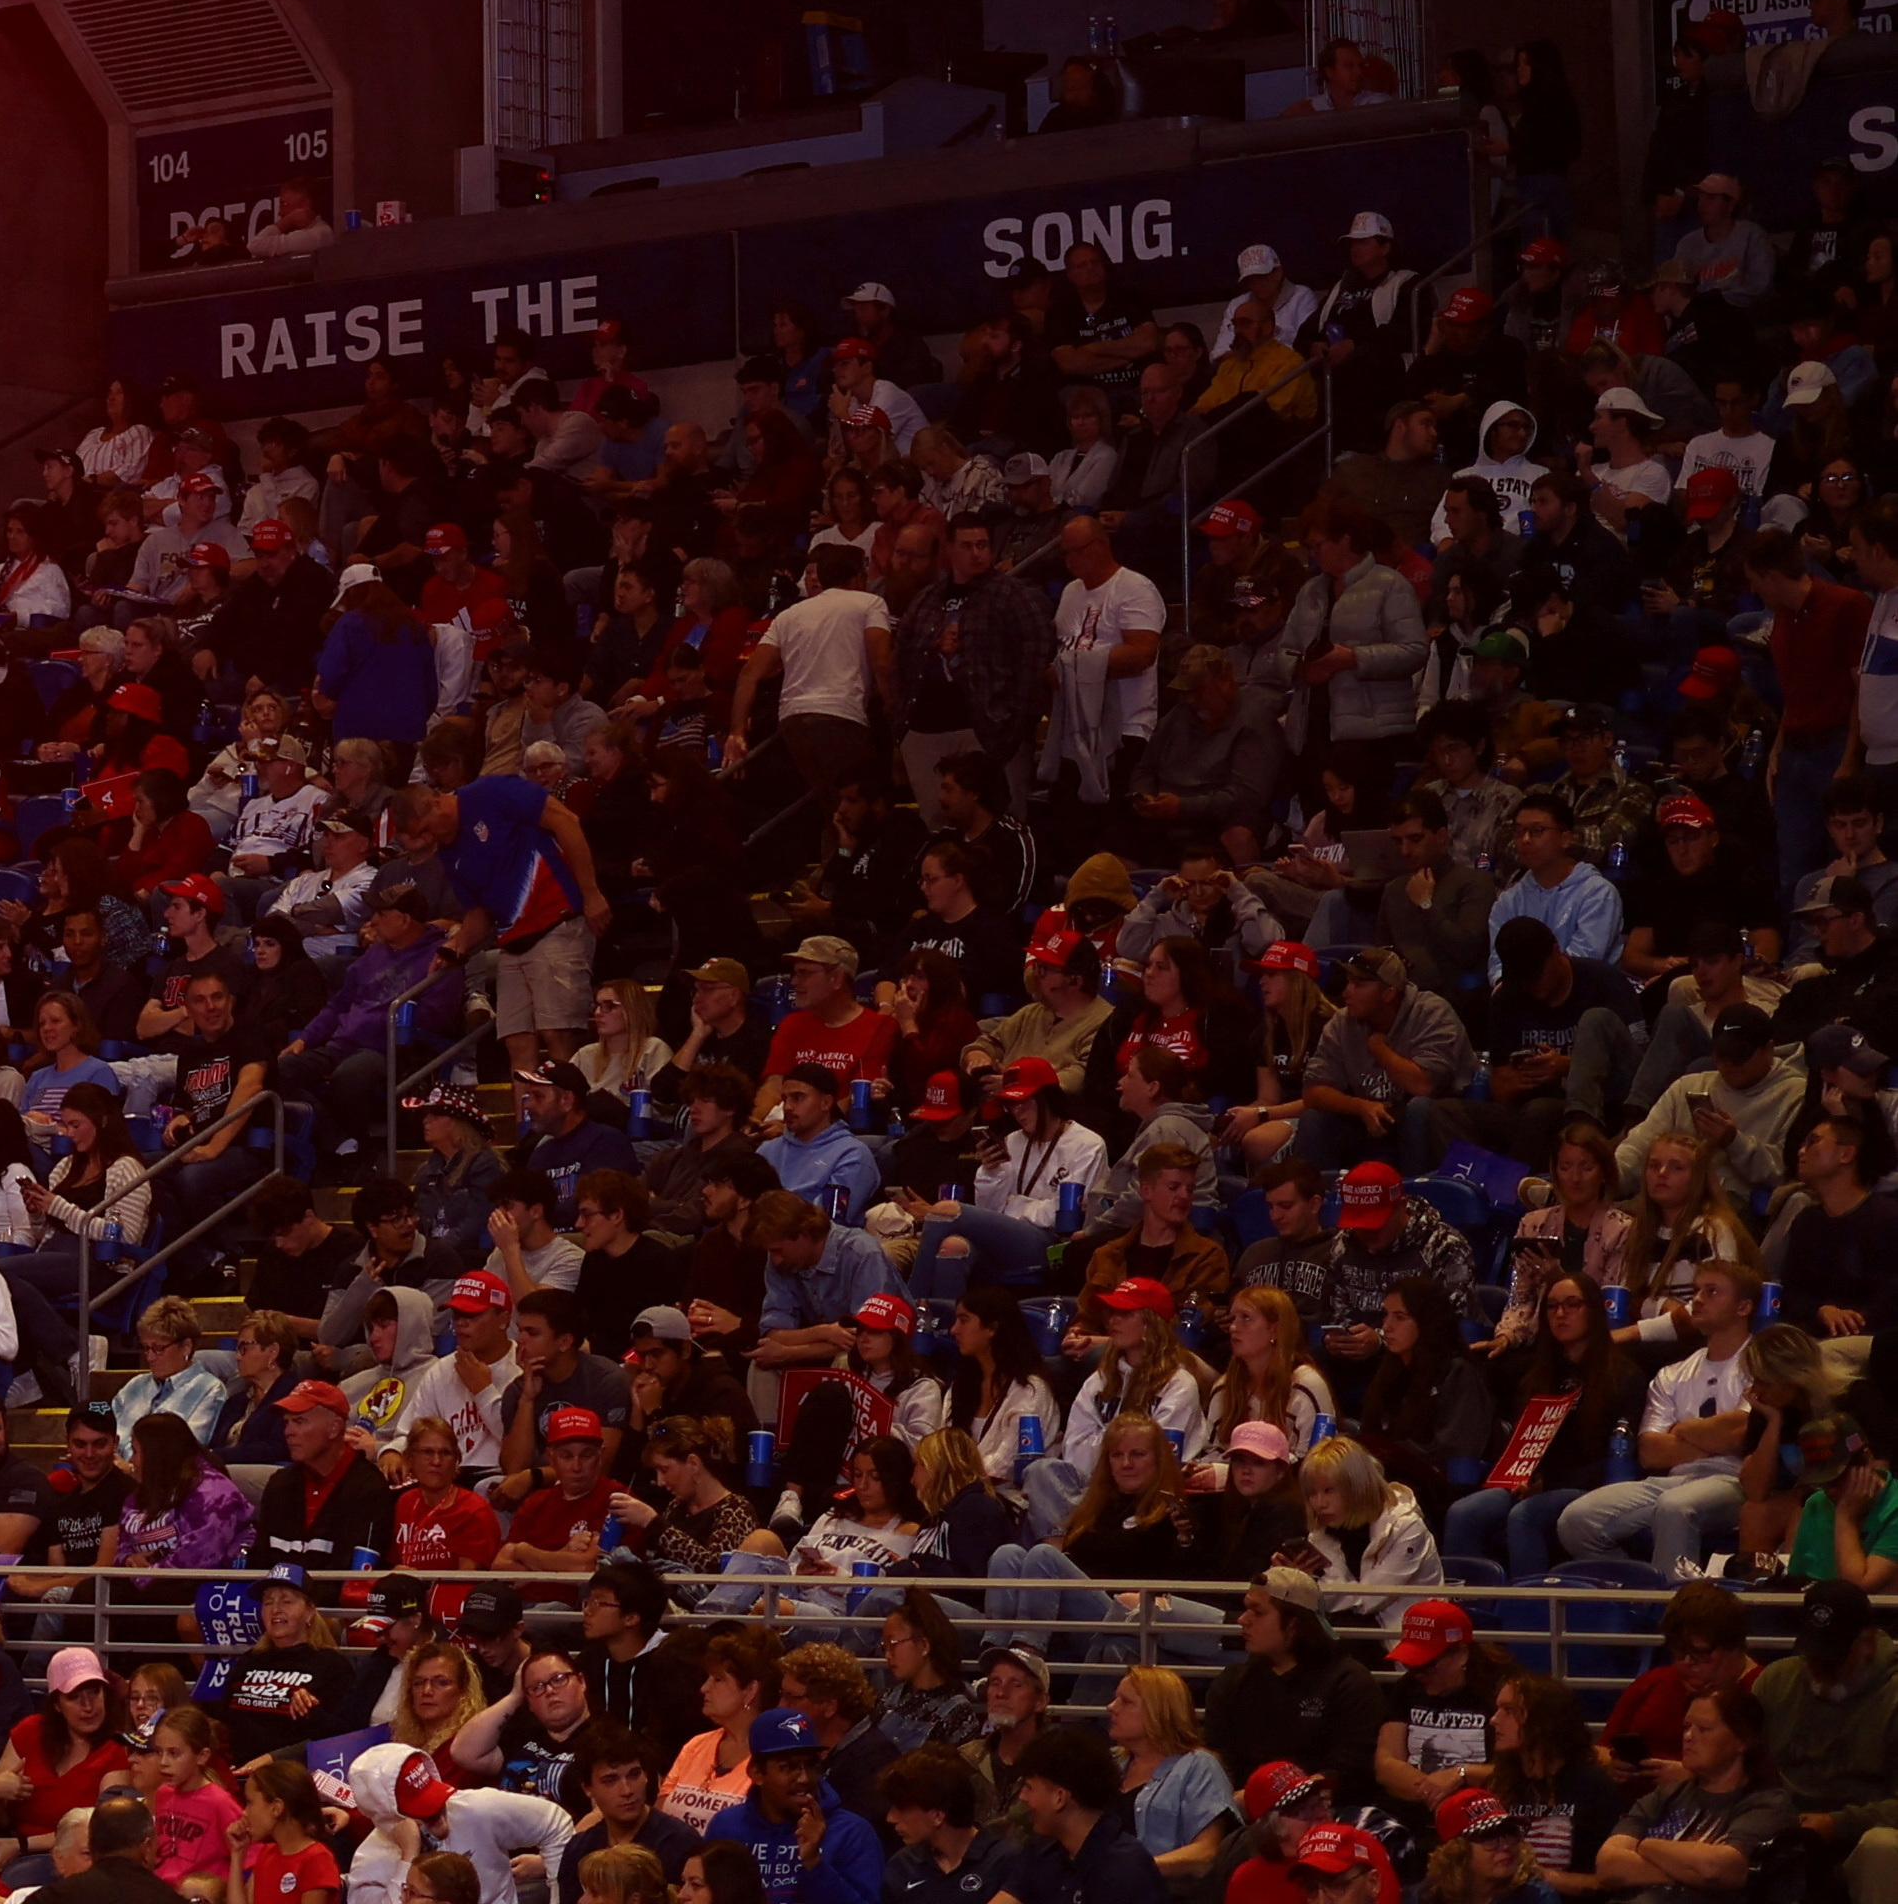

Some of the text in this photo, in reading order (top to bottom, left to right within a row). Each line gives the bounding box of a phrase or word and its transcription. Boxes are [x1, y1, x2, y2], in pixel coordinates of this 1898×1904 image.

[148, 130, 327, 183] 104 105
[983, 198, 1188, 278] SONG.
[220, 275, 600, 378] RAISE THE
[1354, 1184, 1384, 1195] AMERICA
[209, 1583, 228, 1609] TO
[244, 1669, 313, 1686] TRUMP
[240, 1683, 290, 1698] 2024
[252, 1698, 279, 1709] GREAT
[1409, 1708, 1486, 1729] WANTED
[1507, 1802, 1577, 1818] RUMP 2024
[682, 1812, 708, 1829] for
